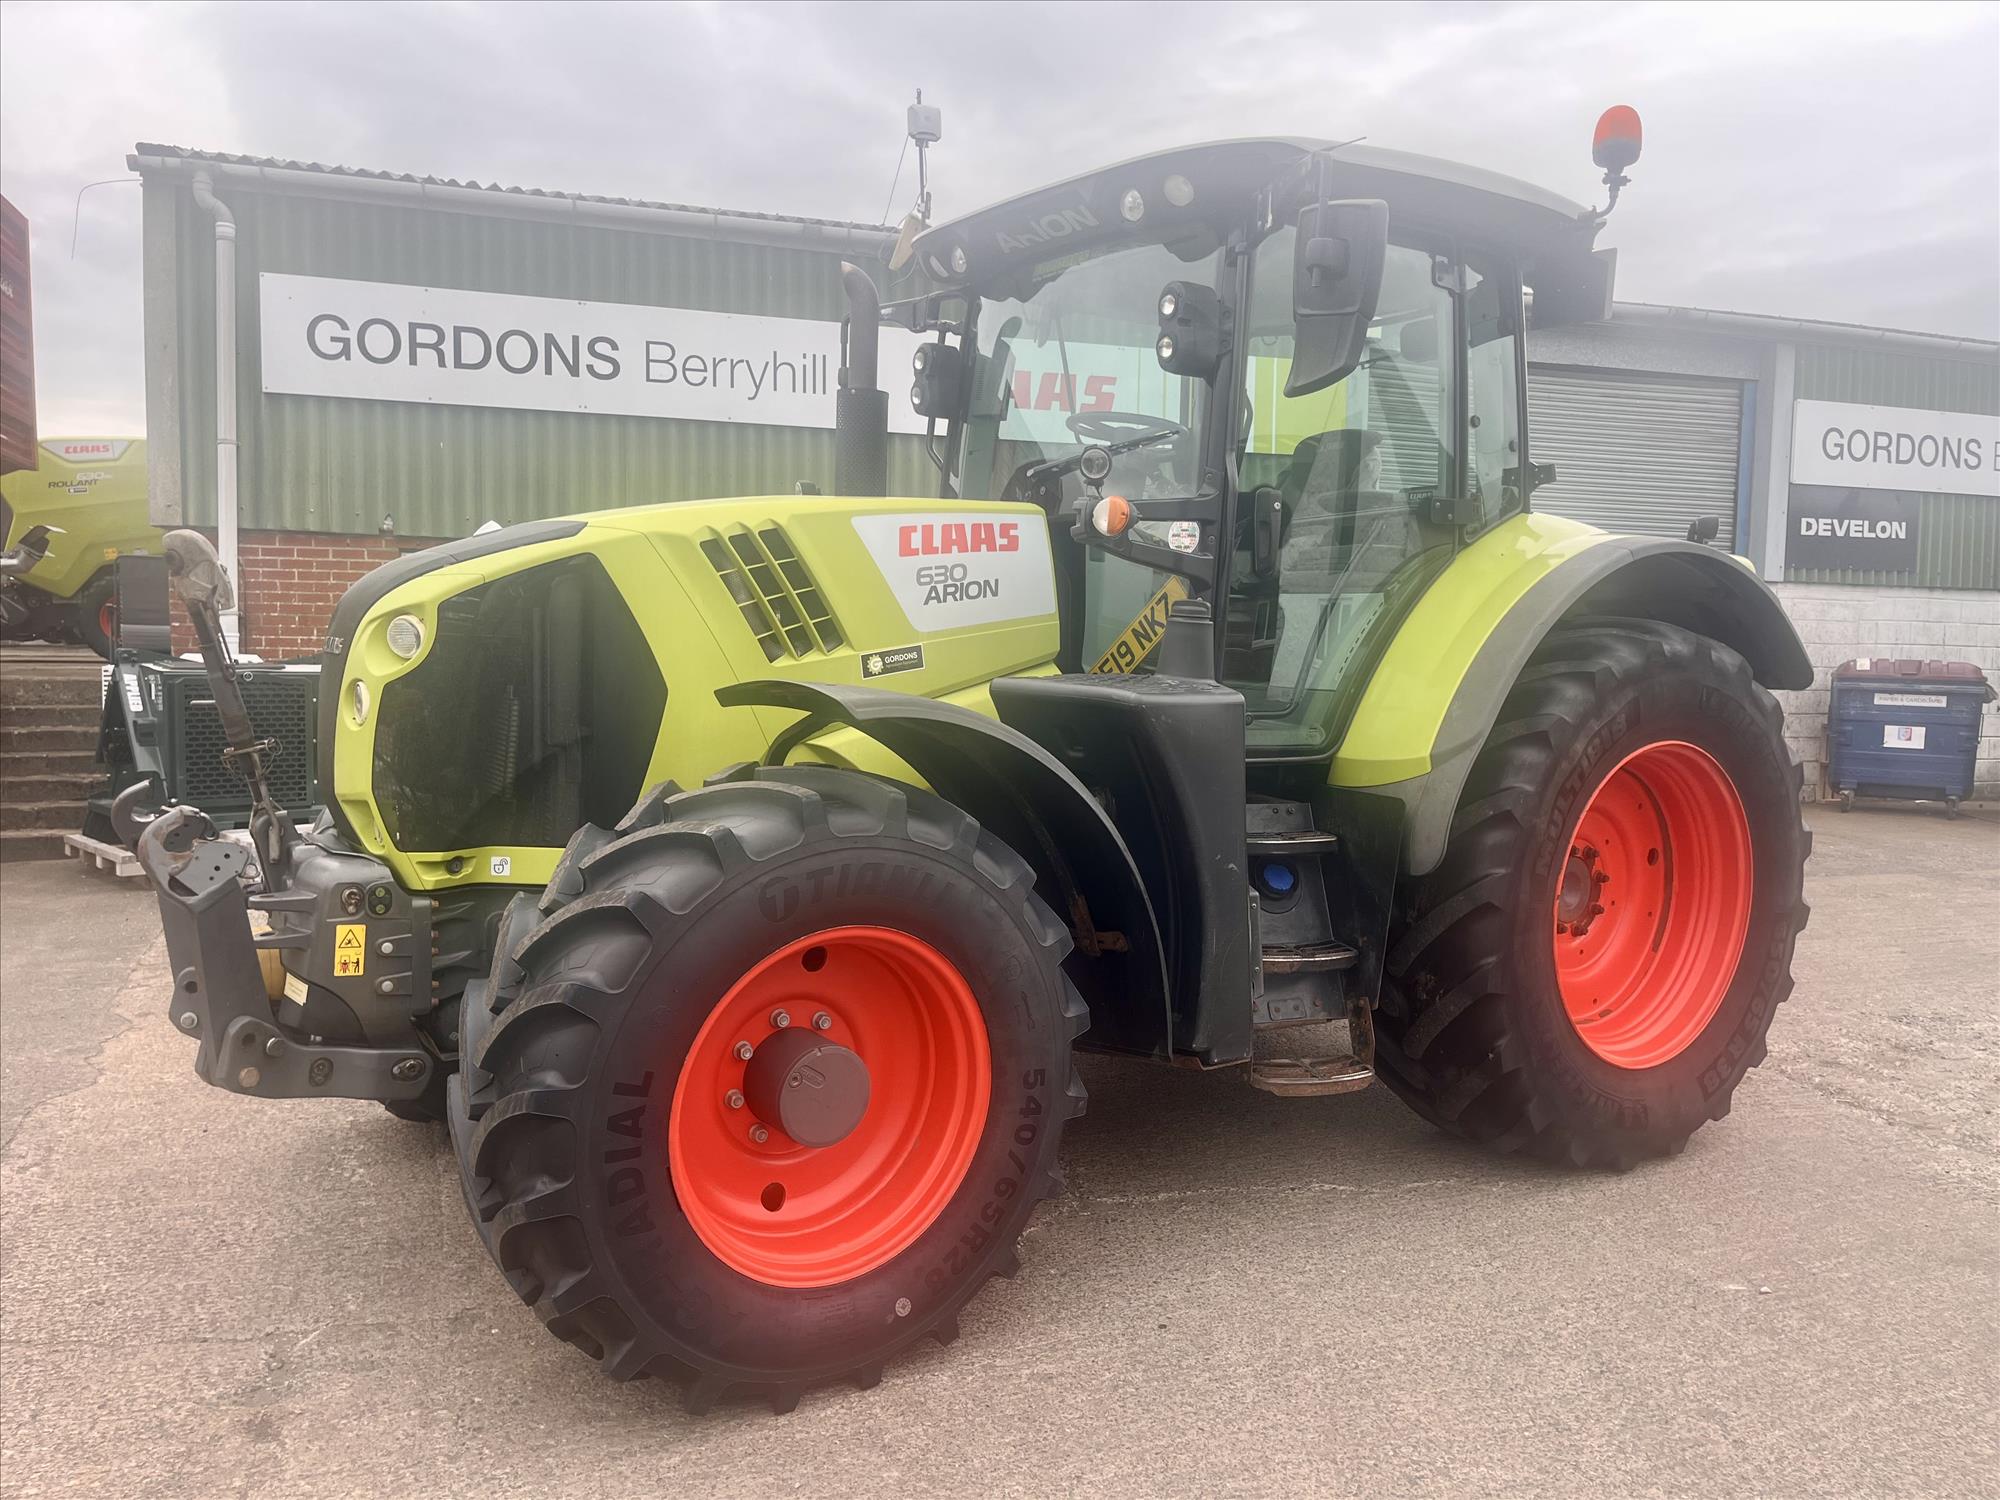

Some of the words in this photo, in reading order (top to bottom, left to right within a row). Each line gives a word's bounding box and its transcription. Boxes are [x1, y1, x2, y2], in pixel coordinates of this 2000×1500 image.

[306, 313, 621, 381] GORDONS
[645, 340, 827, 400] Berryhill
[1010, 370, 1117, 413] AAS
[64, 444, 110, 454] CLAAS
[1822, 427, 1982, 470] GORDONS
[48, 479, 98, 488] ROLLANT
[898, 523, 1019, 557] CLAAS
[1801, 518, 1906, 539] DEVELON
[916, 563, 968, 586] 630
[923, 578, 999, 605] ARION
[885, 652, 918, 664] GORDONS
[924, 1068, 1047, 1297] 540/65R28
